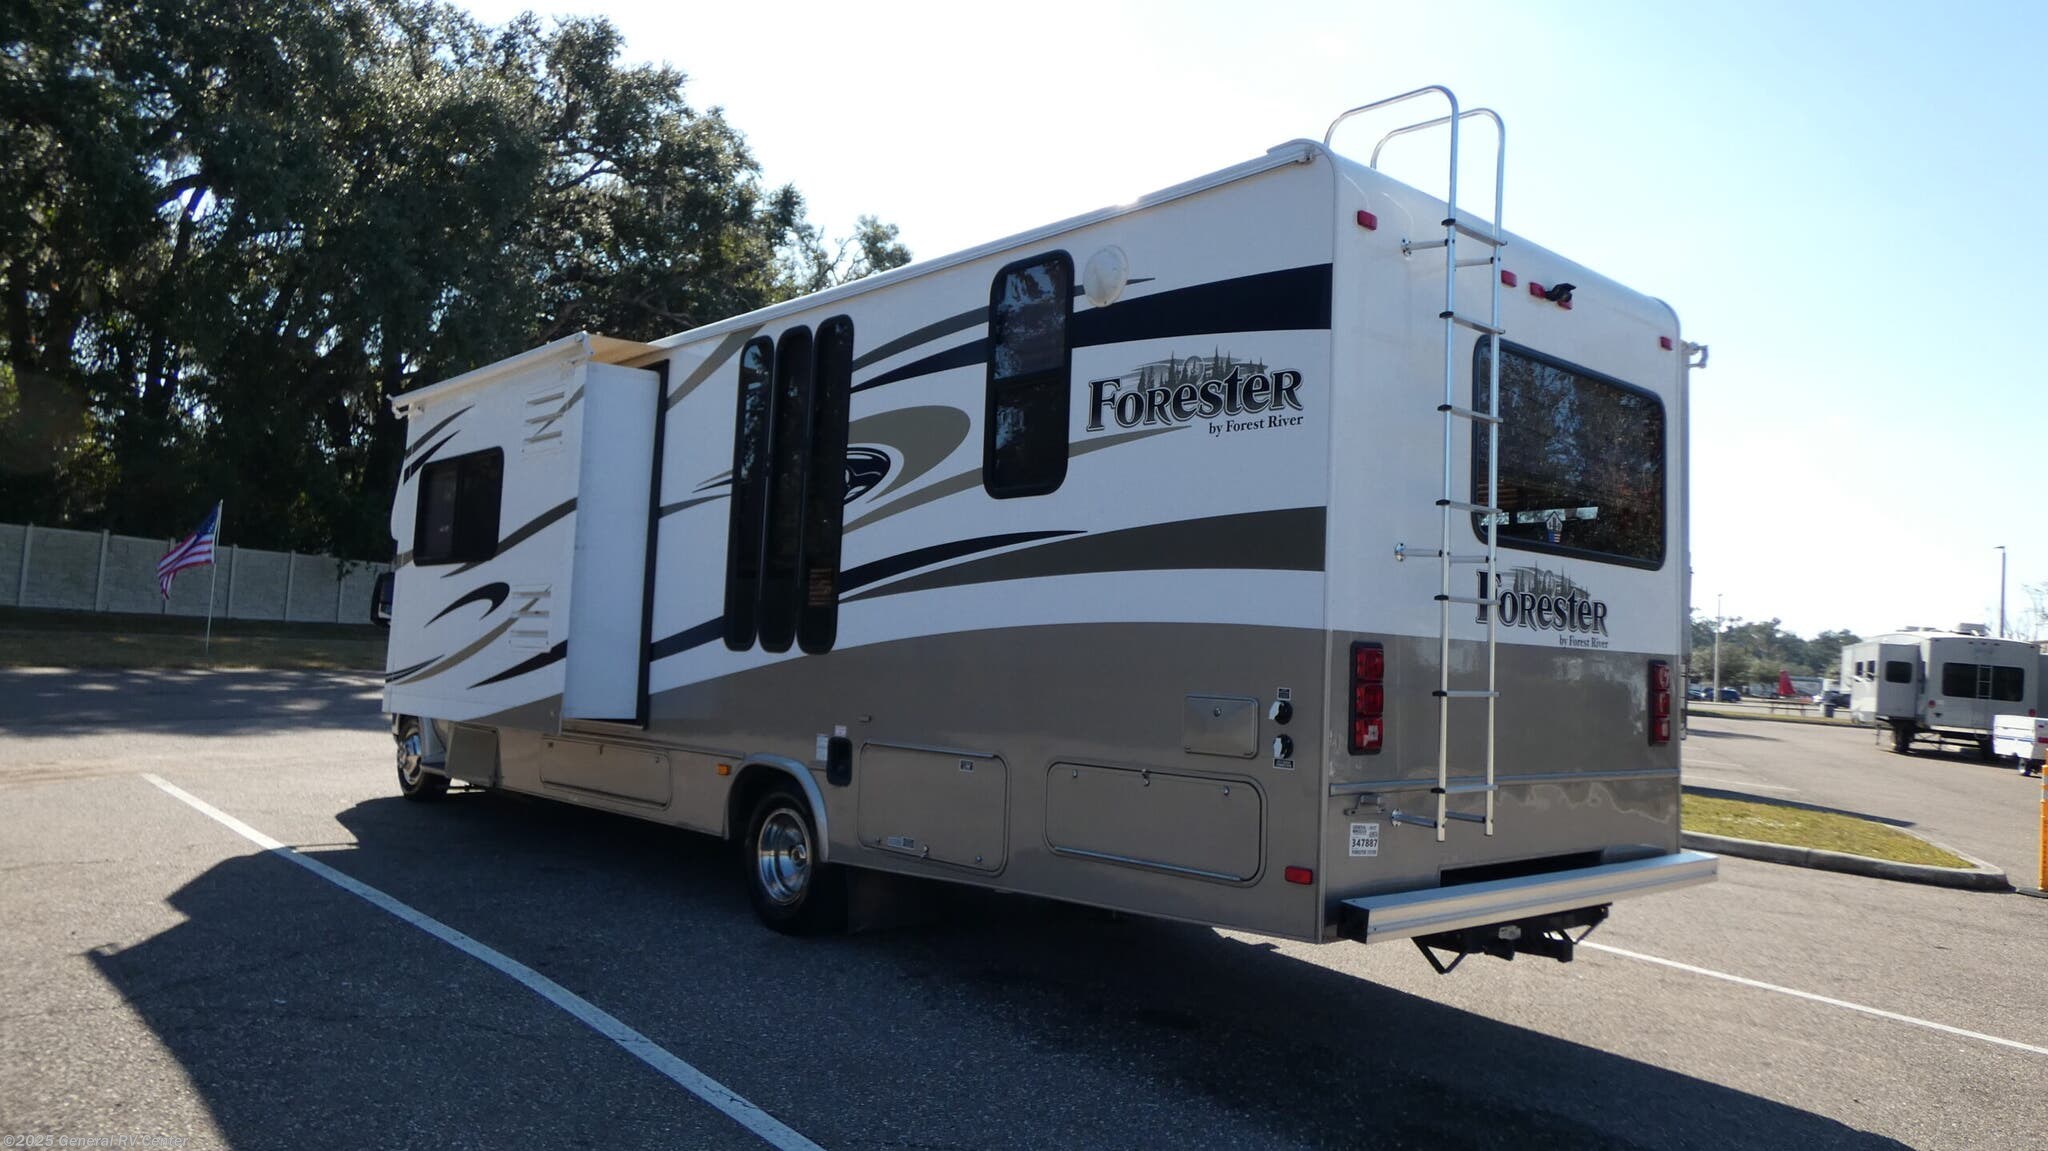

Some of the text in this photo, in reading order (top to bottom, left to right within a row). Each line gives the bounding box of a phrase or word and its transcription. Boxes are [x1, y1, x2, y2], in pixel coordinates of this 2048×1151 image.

[1209, 415, 1304, 437] by Forest River
[1559, 634, 1609, 649] by Forest River
[1352, 838, 1377, 848] 347887
